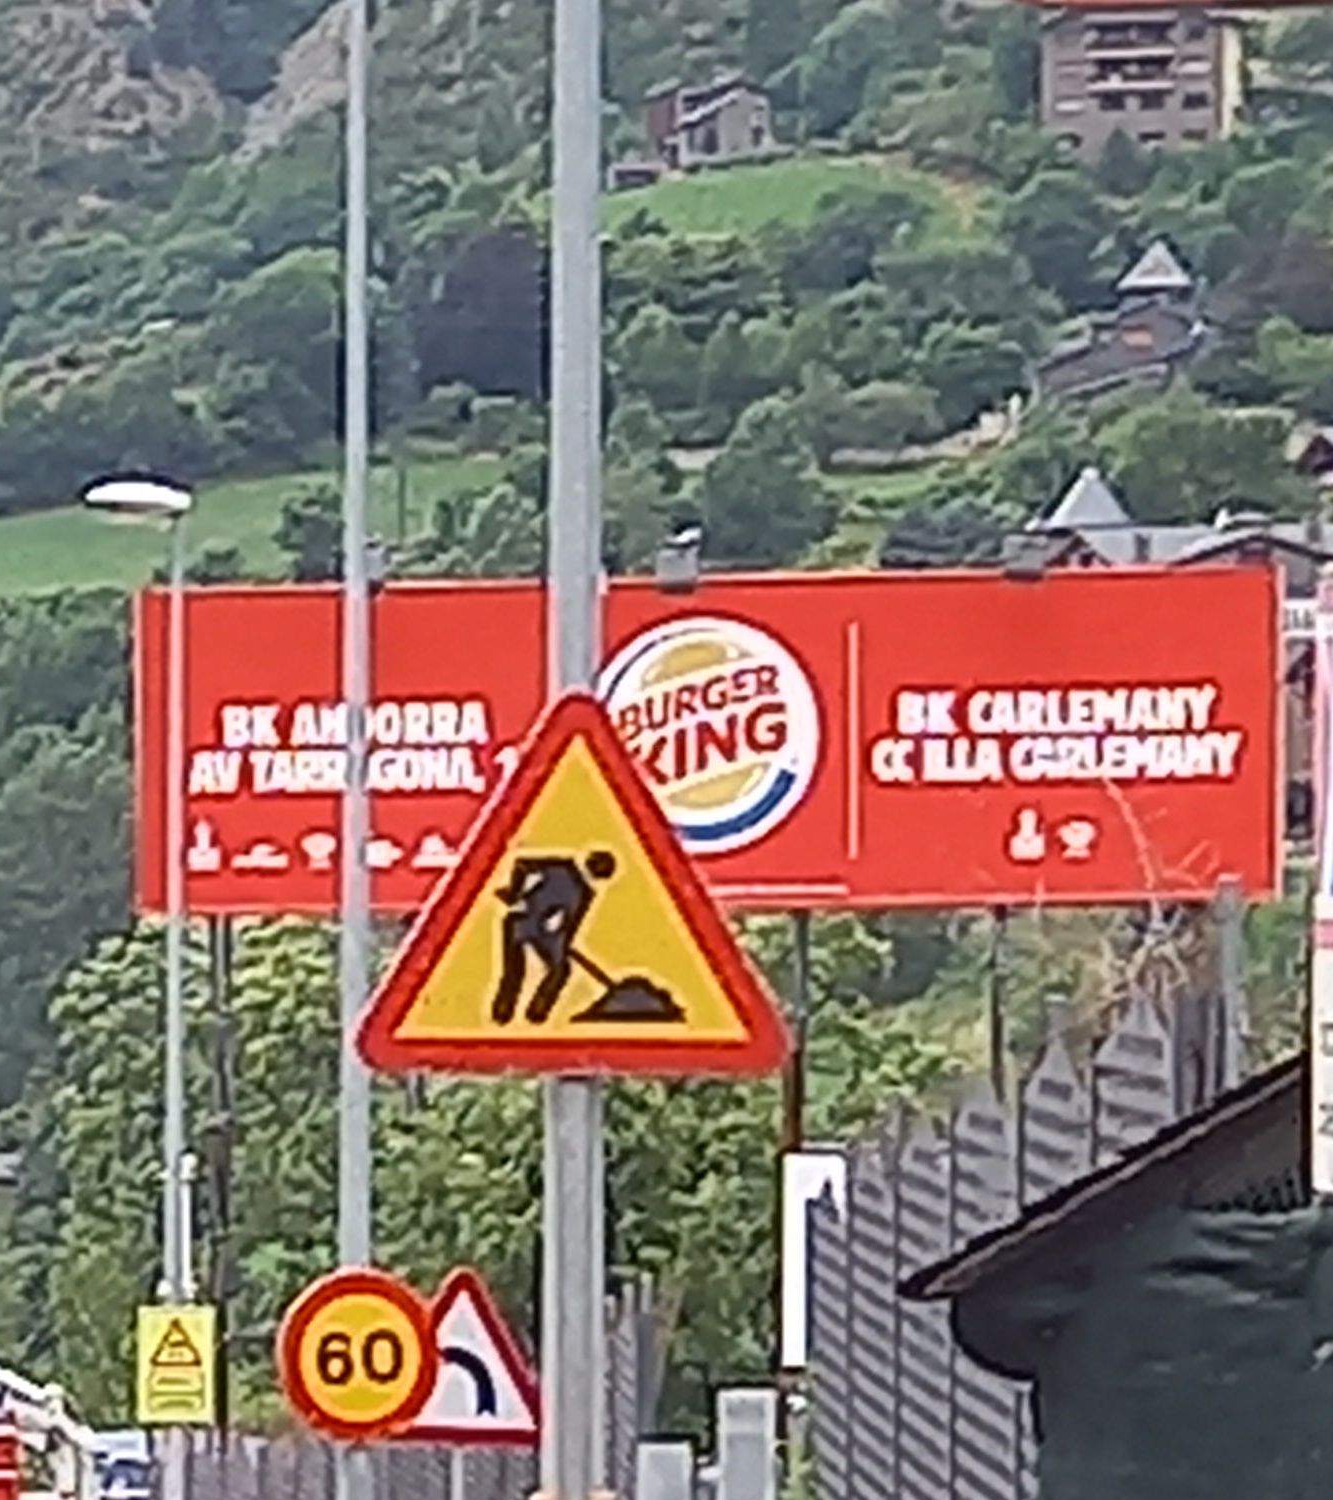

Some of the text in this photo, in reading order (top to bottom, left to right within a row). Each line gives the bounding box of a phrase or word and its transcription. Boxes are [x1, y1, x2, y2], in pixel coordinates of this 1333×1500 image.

[222, 704, 281, 748] BK
[618, 664, 780, 742] BURGER
[897, 684, 1217, 734] BK CARLEMANY
[628, 701, 788, 787] KING
[871, 732, 1242, 782] CC ILLA CARLEMANY
[188, 752, 242, 795] AV
[249, 747, 487, 794] TARRGONA,
[317, 1329, 404, 1386] 60
